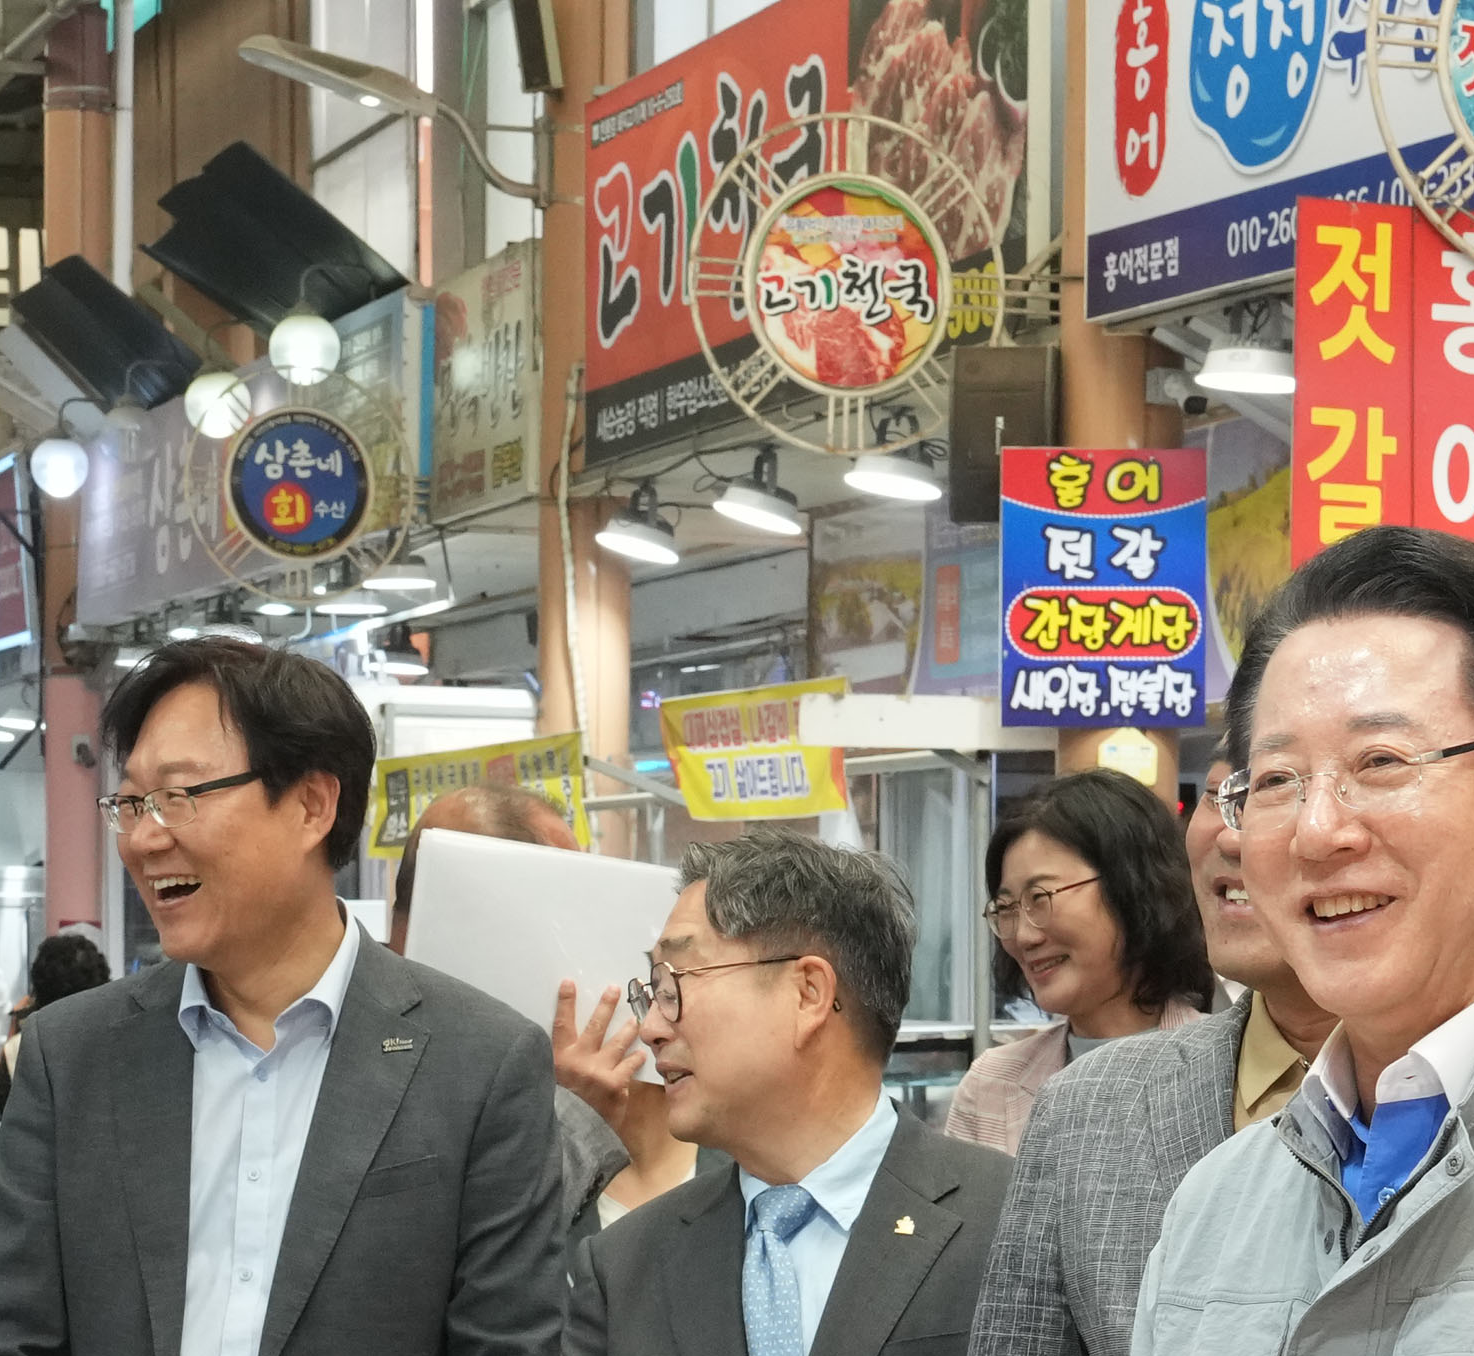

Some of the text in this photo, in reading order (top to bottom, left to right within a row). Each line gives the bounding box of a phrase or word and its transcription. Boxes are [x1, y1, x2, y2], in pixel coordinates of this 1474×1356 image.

[759, 255, 934, 322] 고기천국
[1103, 235, 1180, 294] 홍어전문점
[1306, 221, 1398, 546] 젓갈
[253, 438, 343, 481] 삼촌네
[1048, 453, 1161, 509] 홍어
[270, 487, 347, 527] 회 수산
[1043, 525, 1166, 580] 젓갈
[1023, 596, 1195, 652] 간장게장
